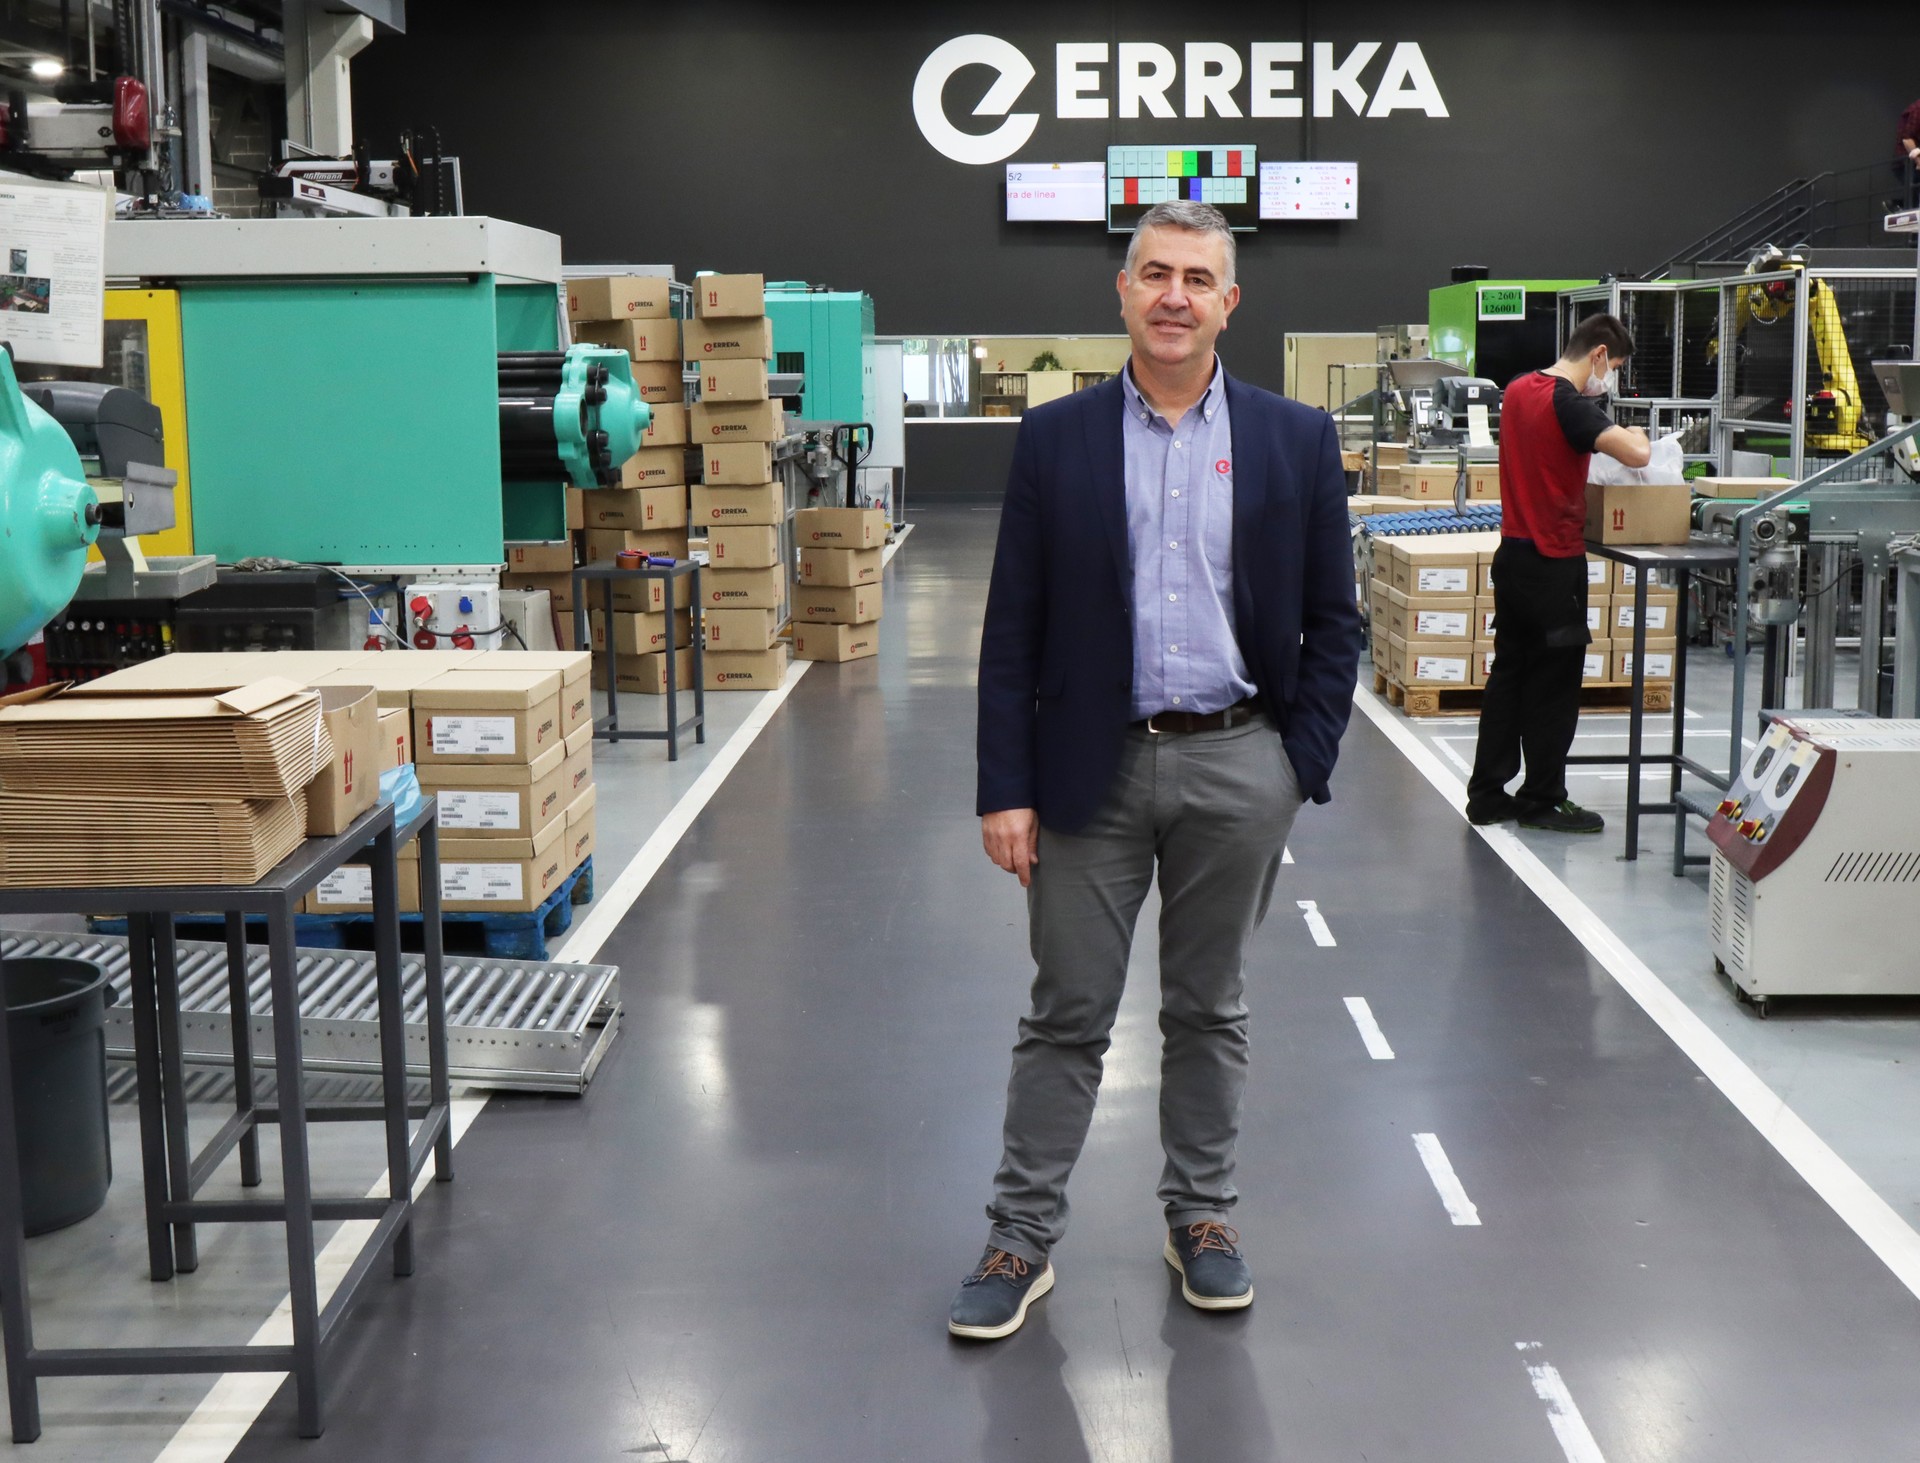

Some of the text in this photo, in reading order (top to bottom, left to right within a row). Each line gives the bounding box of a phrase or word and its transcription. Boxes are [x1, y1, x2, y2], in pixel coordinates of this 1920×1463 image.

[1056, 41, 1450, 118] ERREKA
[1485, 305, 1516, 313] 126001
[713, 341, 740, 349] ERREKA
[645, 469, 666, 477] ERREKA
[726, 672, 753, 680] ERREKA
